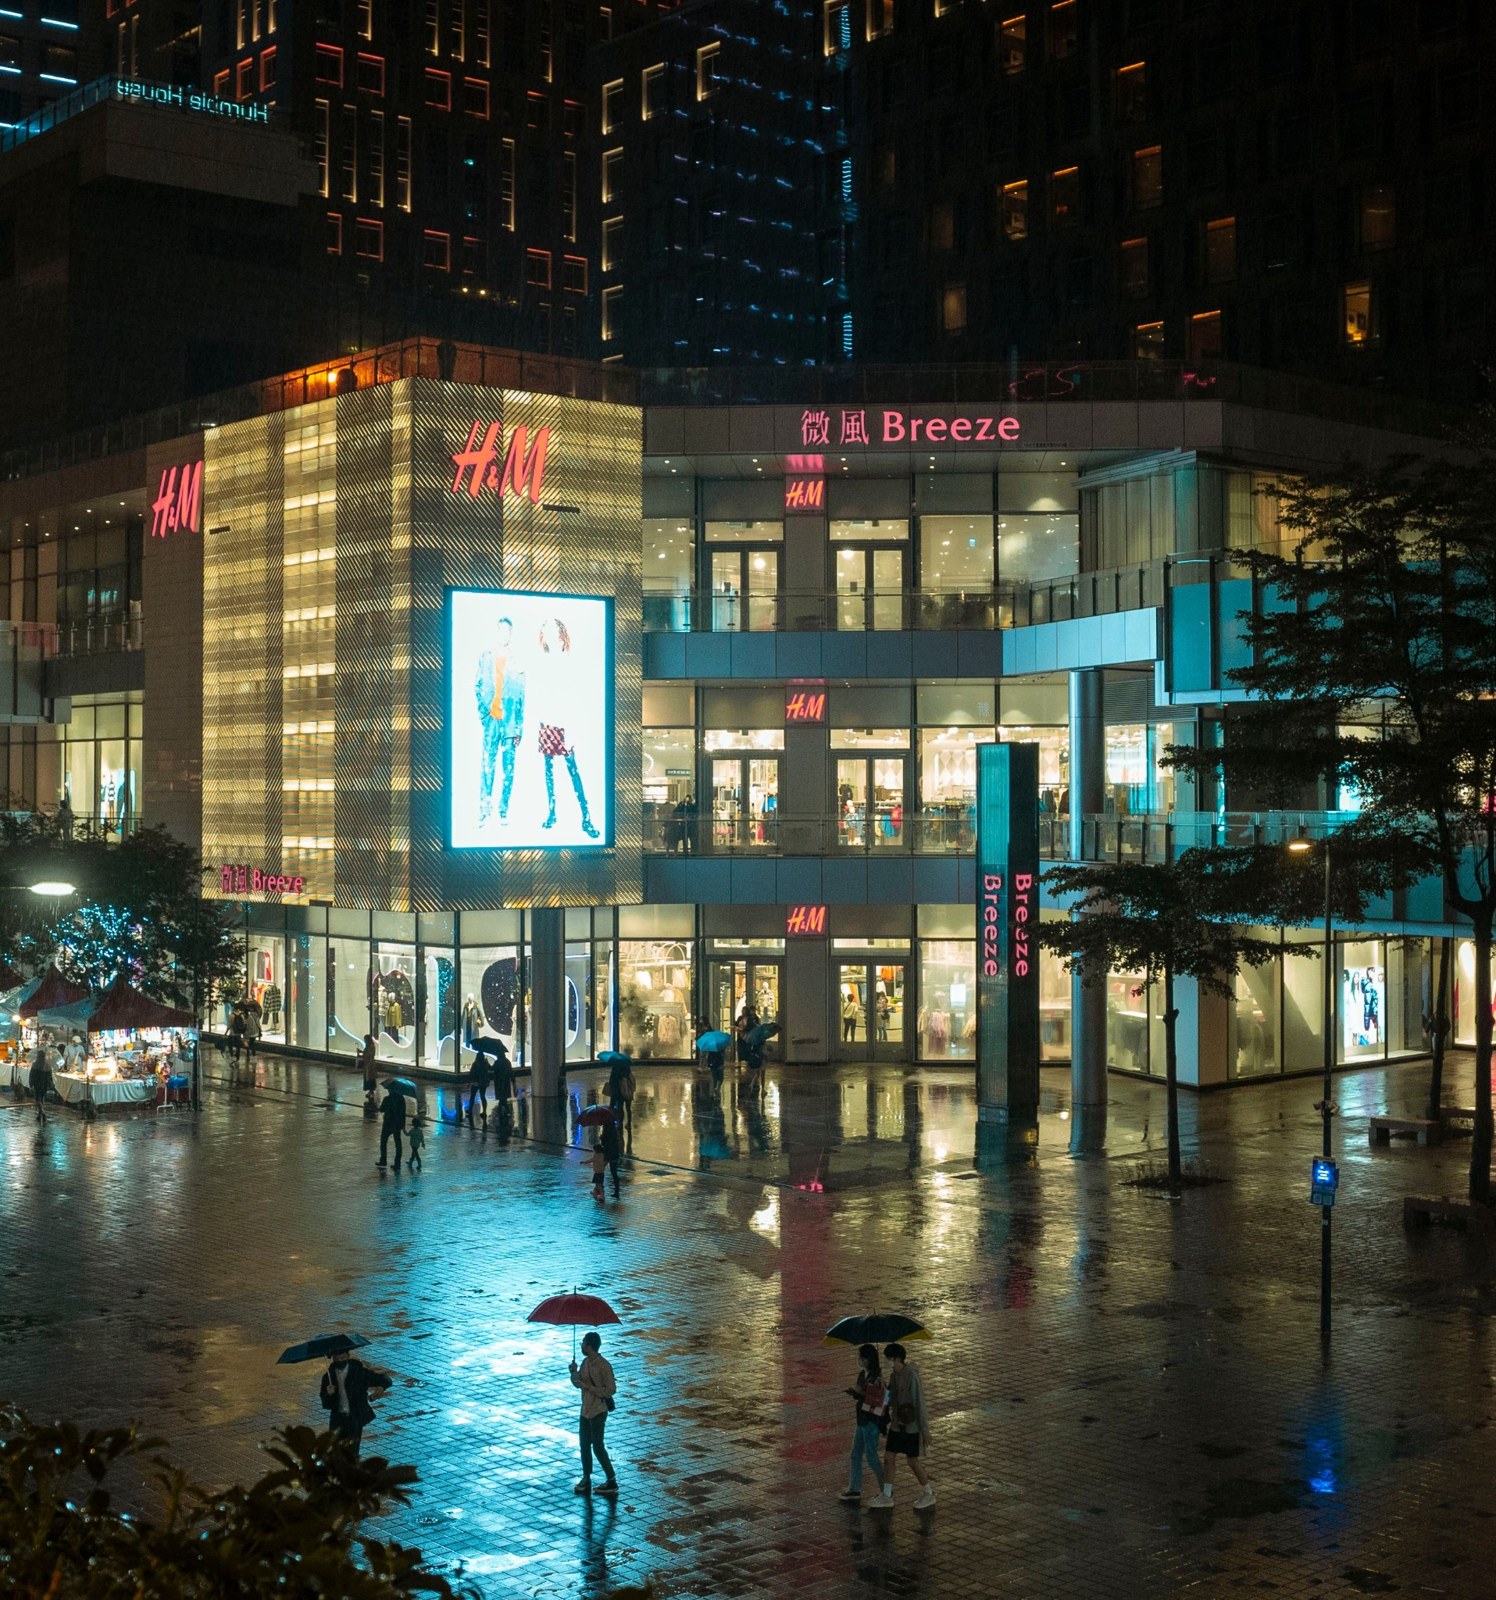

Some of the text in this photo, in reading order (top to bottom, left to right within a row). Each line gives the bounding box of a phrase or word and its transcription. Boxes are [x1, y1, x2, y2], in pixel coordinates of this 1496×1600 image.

[801, 409, 1021, 446] 微風 Breeze
[452, 419, 551, 505] H&M
[151, 460, 204, 538] H&M
[785, 480, 824, 508] H&M
[786, 693, 825, 720] H&M
[252, 867, 304, 894] Breeze
[787, 906, 826, 933] H&M
[984, 873, 1002, 976] Breeze
